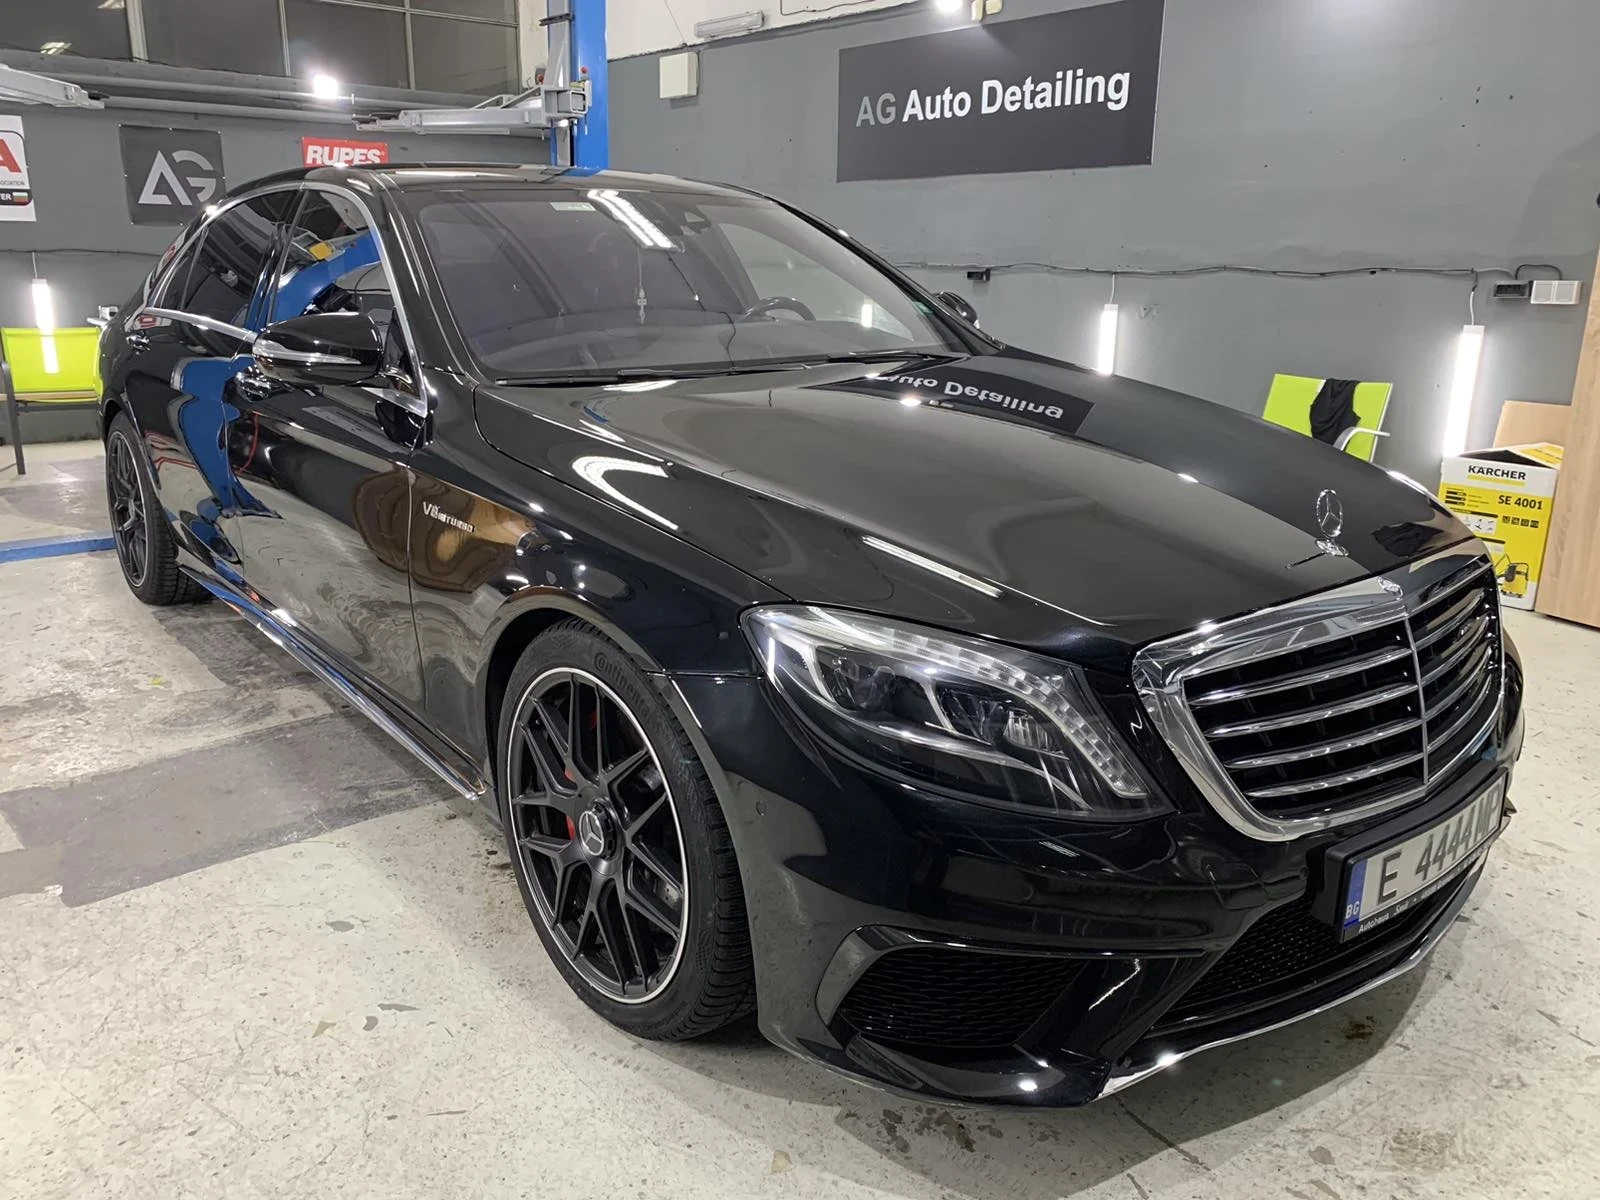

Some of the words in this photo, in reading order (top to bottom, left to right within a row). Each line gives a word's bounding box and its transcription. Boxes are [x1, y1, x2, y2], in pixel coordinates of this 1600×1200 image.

[856, 93, 896, 127] AG
[902, 87, 972, 122] Auto
[981, 68, 1131, 111] Detailing
[138, 150, 217, 206] AG
[1468, 465, 1526, 480] KÄRCHER
[1498, 494, 1512, 506] SE
[1514, 497, 1543, 510] 4001
[1378, 850, 1402, 905] E
[1345, 901, 1360, 919] BG
